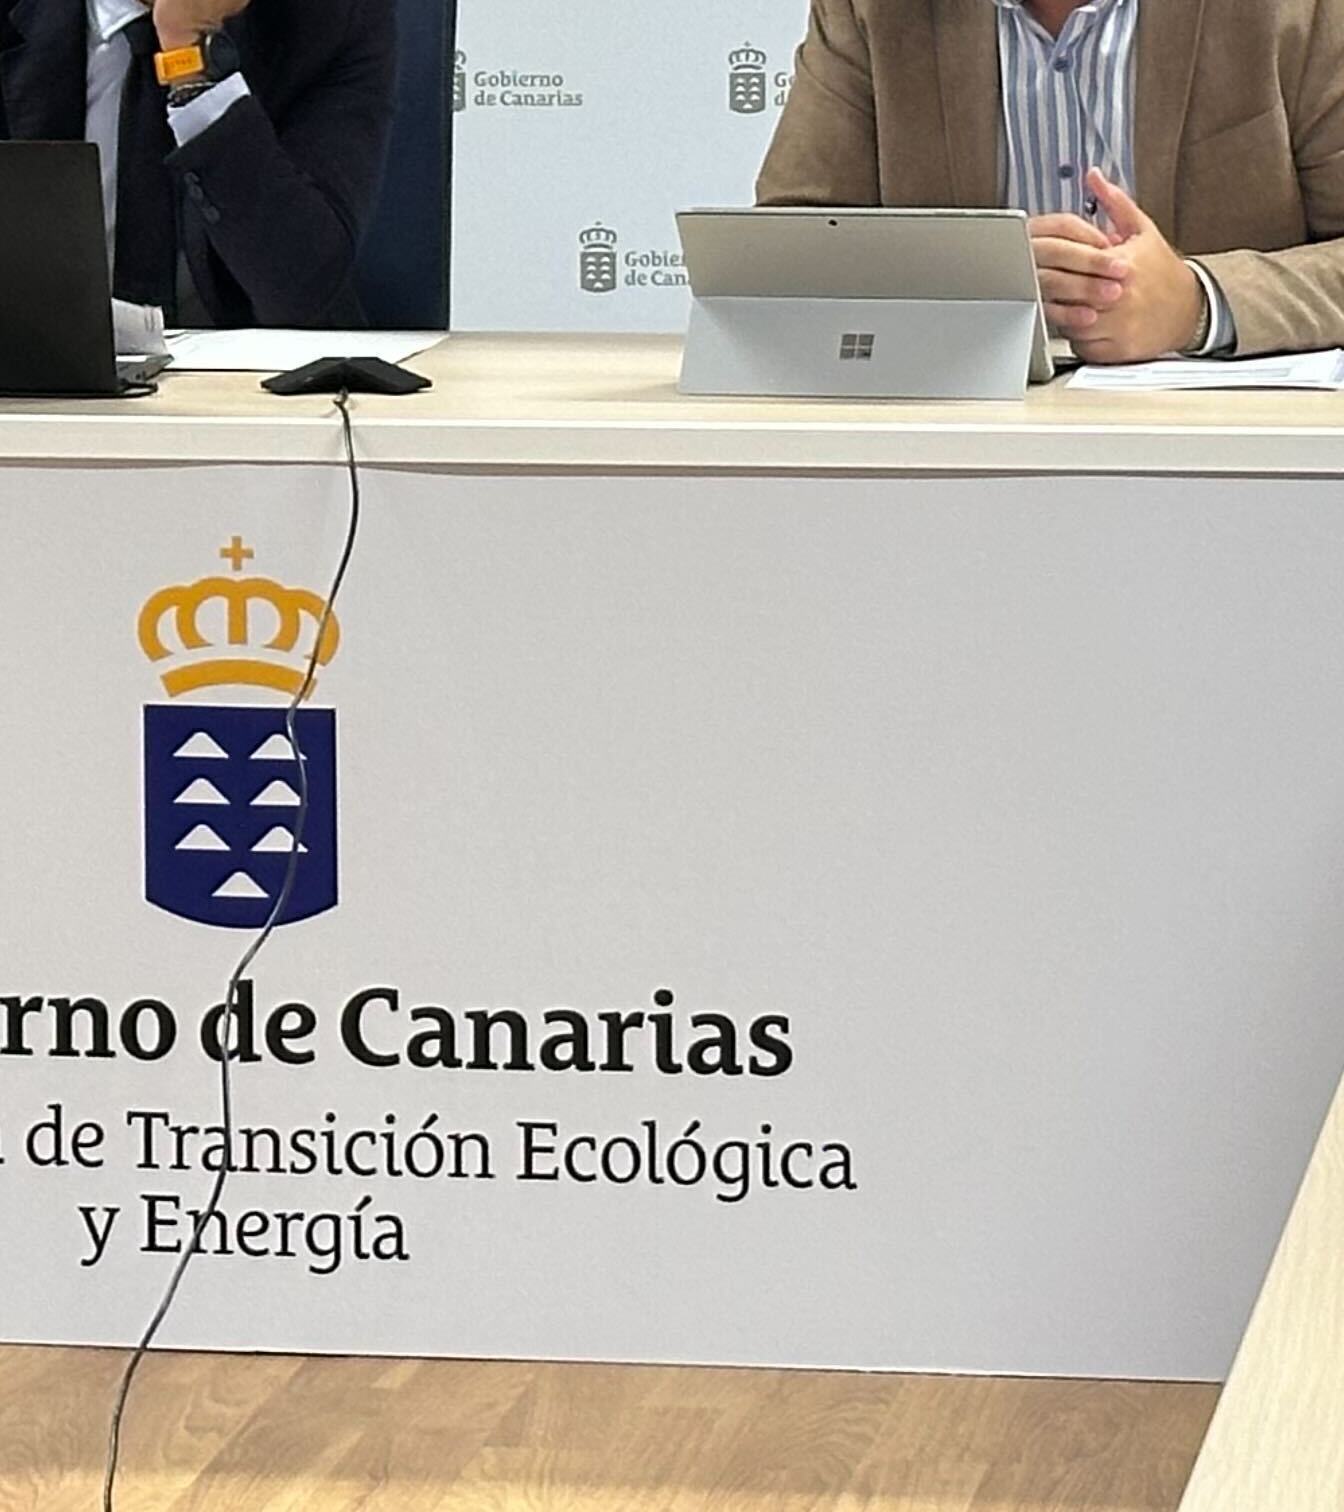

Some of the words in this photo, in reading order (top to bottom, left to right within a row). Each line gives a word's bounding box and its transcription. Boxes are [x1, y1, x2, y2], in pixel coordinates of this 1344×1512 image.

[473, 69, 564, 88] Gobierno
[473, 89, 497, 107] de
[499, 89, 583, 107] Canarias
[623, 269, 648, 286] de
[200, 982, 317, 1065] de
[340, 987, 793, 1077] Canarias
[26, 1103, 104, 1168] de
[126, 1111, 495, 1181] Transición
[516, 1121, 858, 1203] Ecológica
[78, 1206, 121, 1267] y
[140, 1194, 410, 1275] Energía
